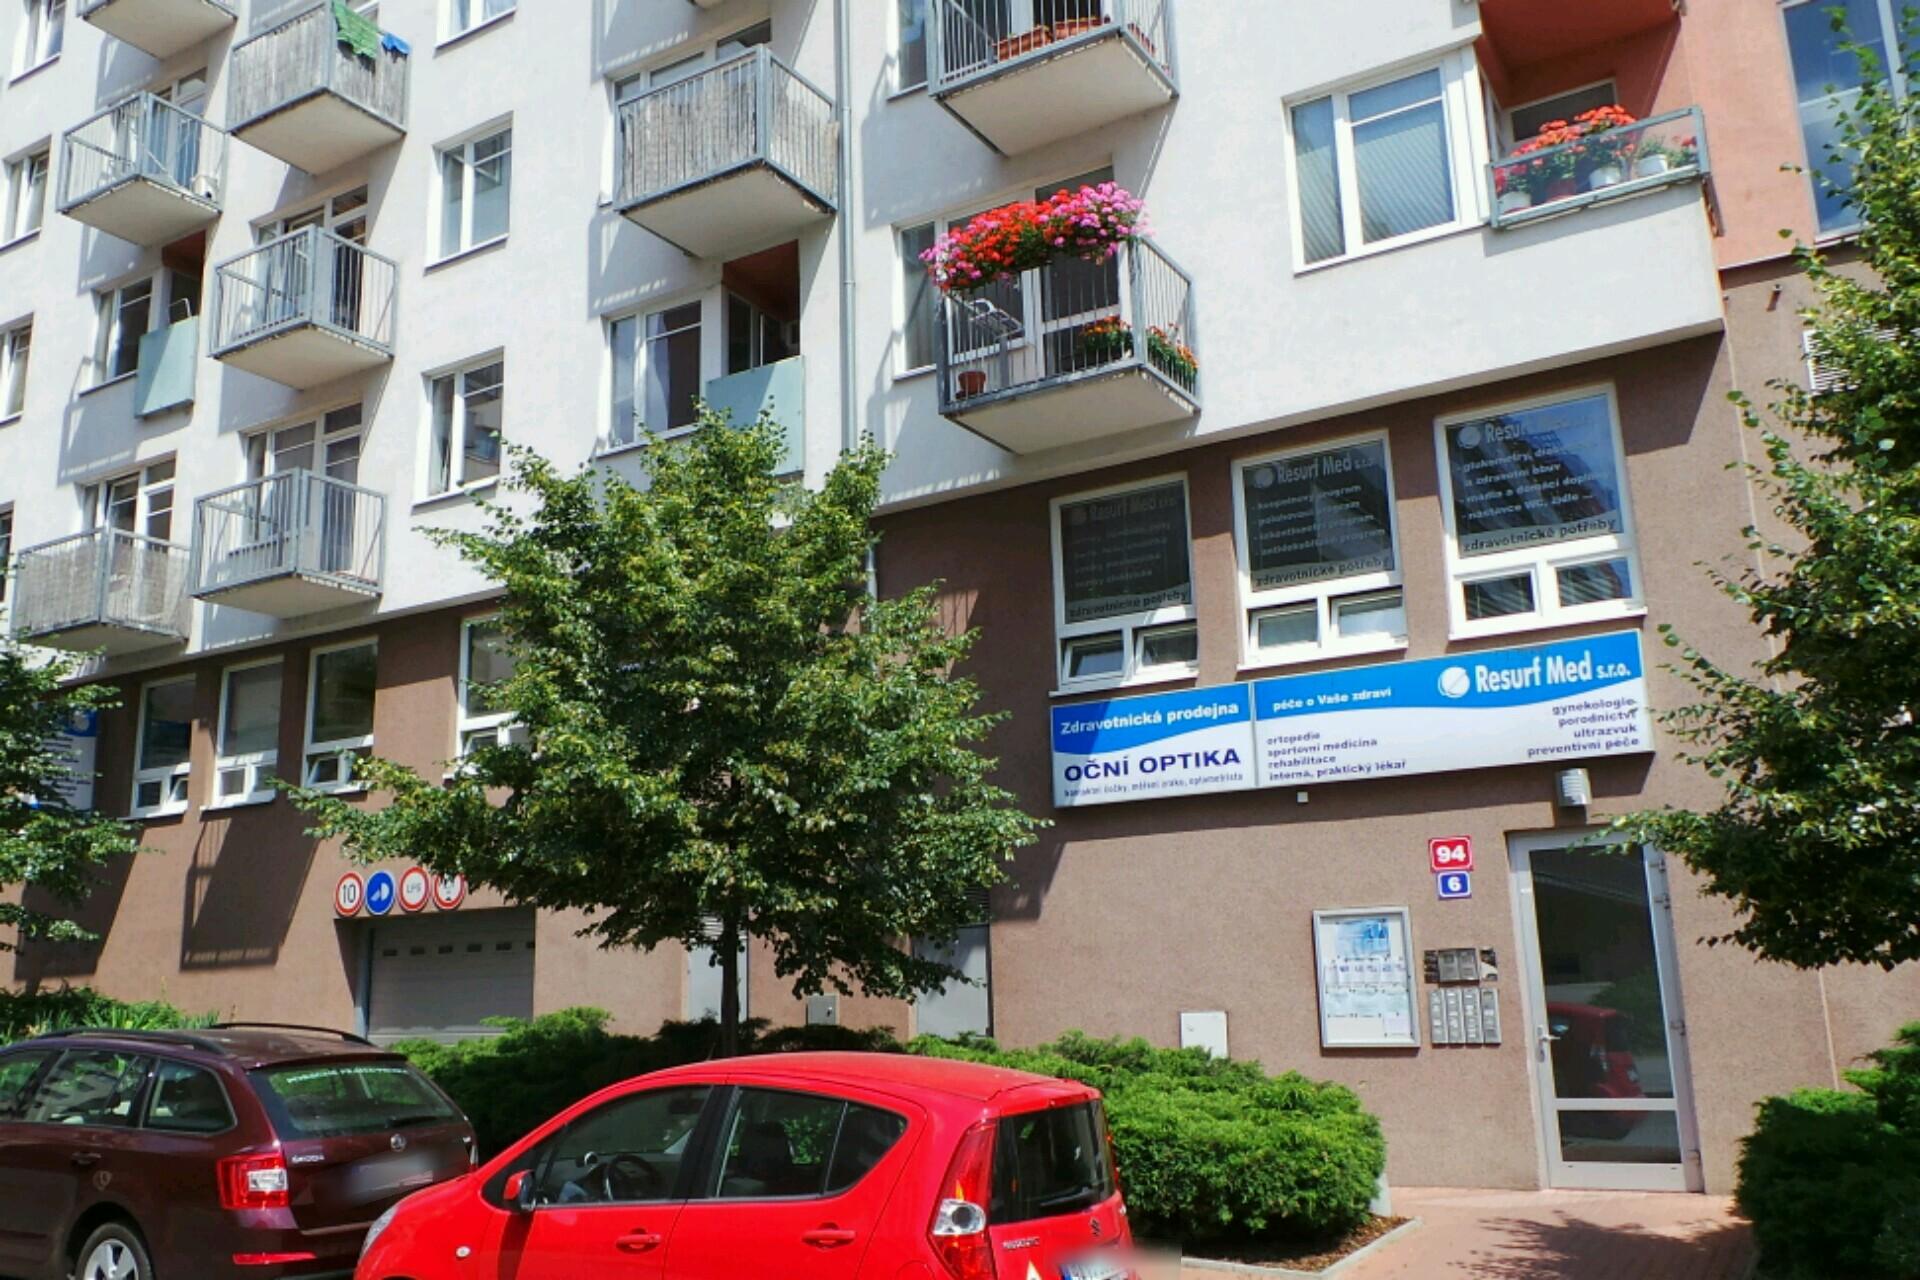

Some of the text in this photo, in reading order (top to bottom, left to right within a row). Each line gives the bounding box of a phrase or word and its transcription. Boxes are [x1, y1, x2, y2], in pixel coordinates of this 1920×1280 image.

[1322, 453, 1353, 477] Med
[1475, 650, 1632, 694] Resurf Med s.r.o.
[1272, 685, 1392, 713] péče o Vaše zdraví
[1552, 695, 1634, 717] gynekologie
[1060, 702, 1240, 736] Zdravotnická prodejna
[1266, 731, 1321, 746] ortopedie
[1574, 723, 1637, 739] ultrazvuk
[1527, 739, 1601, 759] preventivní
[1063, 747, 1242, 783] OČNÍ OPTIKA
[1268, 754, 1337, 769] rehabilitace
[1317, 761, 1372, 779] praktický
[1436, 844, 1467, 864] 94
[343, 883, 357, 903] 10
[1447, 876, 1462, 892] 6
